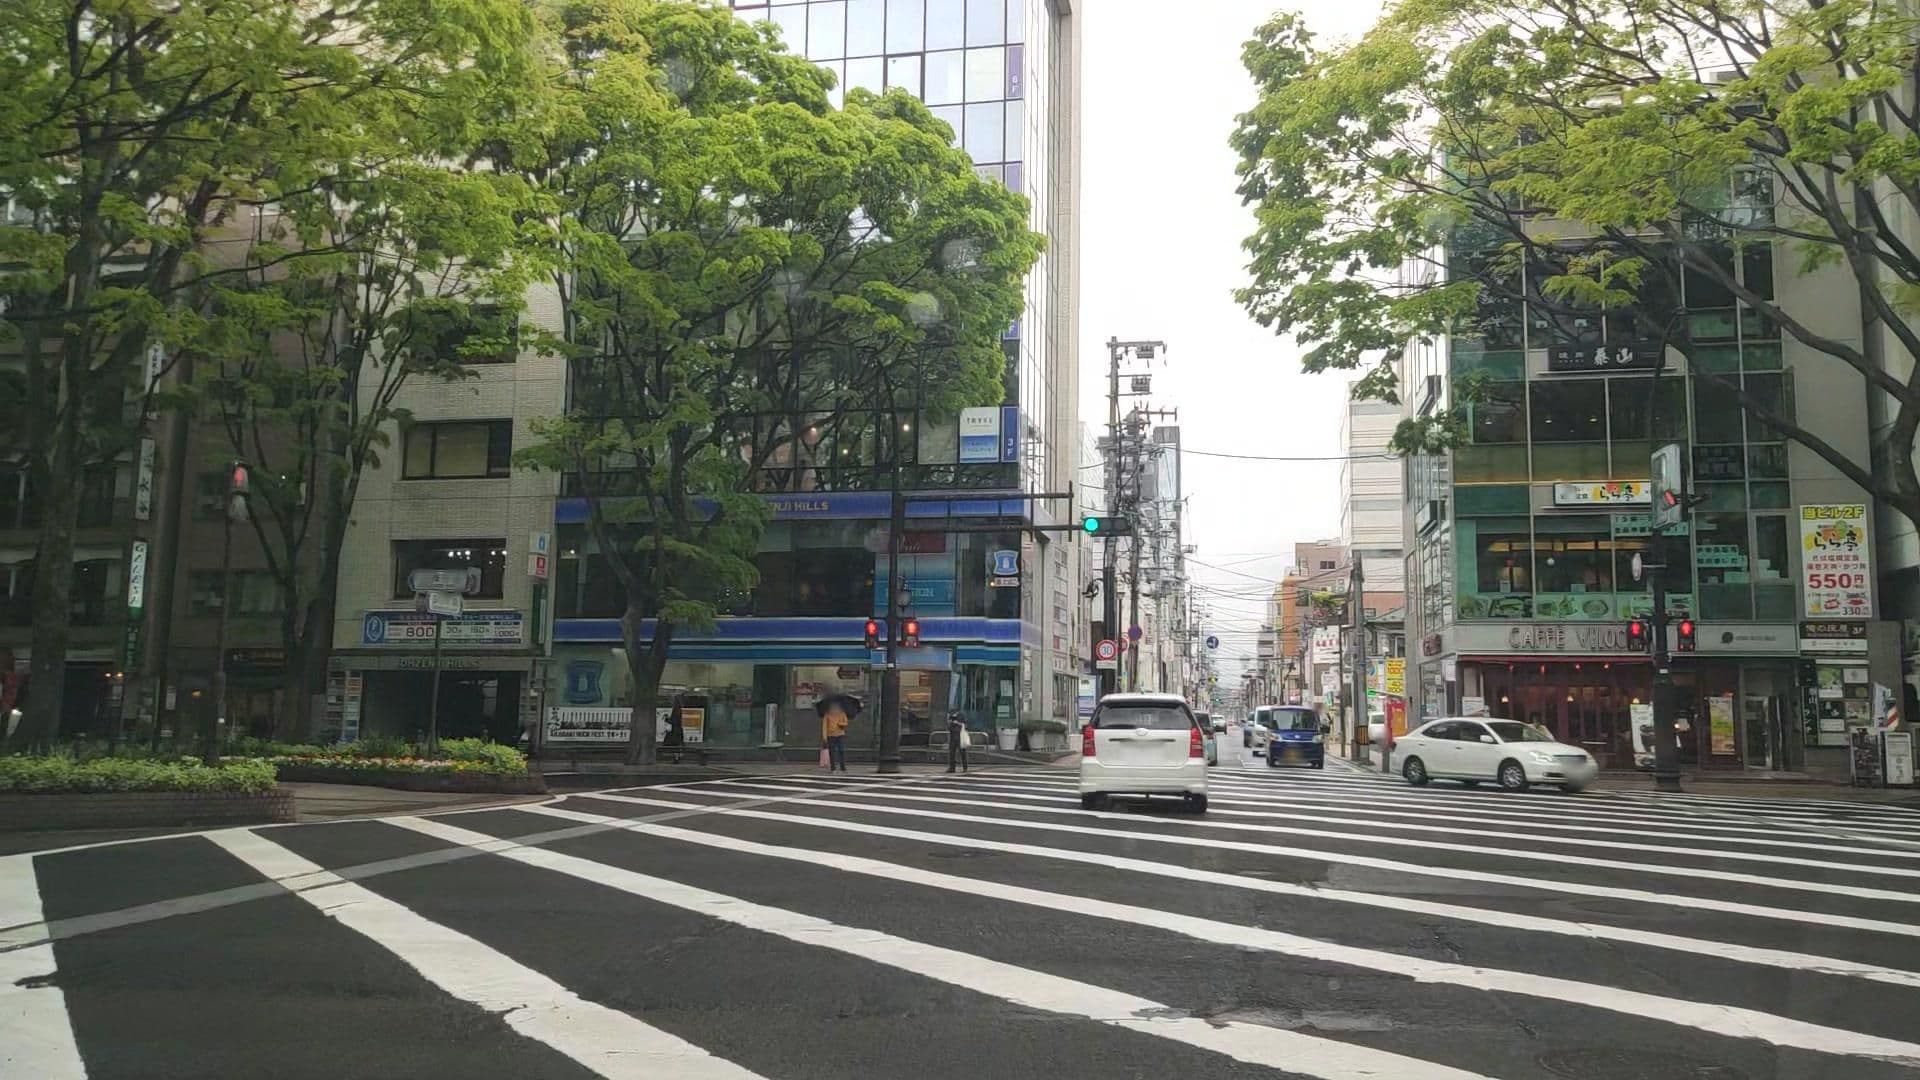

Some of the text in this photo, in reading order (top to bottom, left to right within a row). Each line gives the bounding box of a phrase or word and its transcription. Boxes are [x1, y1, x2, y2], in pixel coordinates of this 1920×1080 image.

[1007, 438, 1014, 456] 3F
[794, 501, 829, 512] HILLS
[1814, 530, 1858, 551] らら亭
